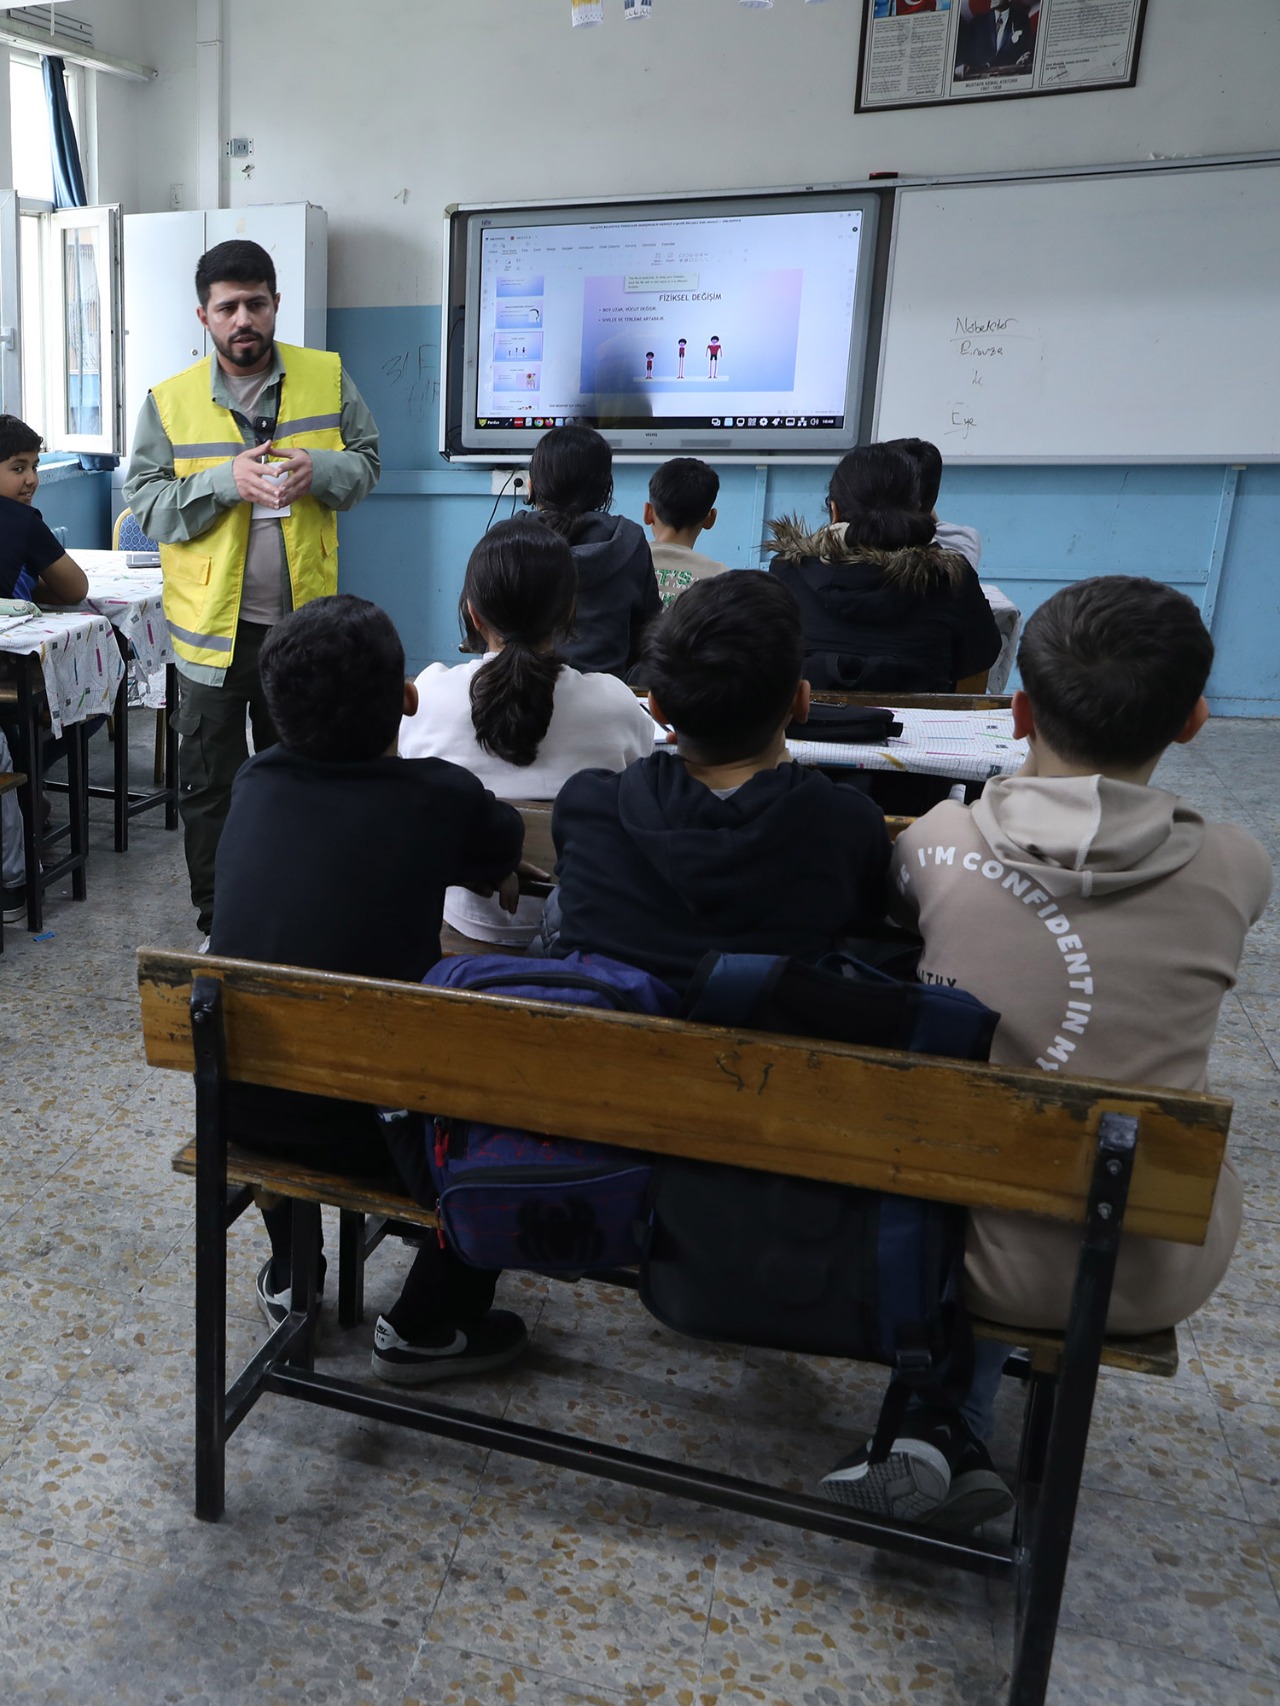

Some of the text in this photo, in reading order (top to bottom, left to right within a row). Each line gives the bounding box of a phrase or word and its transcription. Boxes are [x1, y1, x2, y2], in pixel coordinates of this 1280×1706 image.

[658, 291, 722, 302] FİZİKSEL DEĞİŞİM
[917, 845, 957, 868] I'M
[962, 851, 1095, 996] CONFIDENT
[1061, 1000, 1093, 1036] IN
[1035, 1035, 1077, 1073] MY
